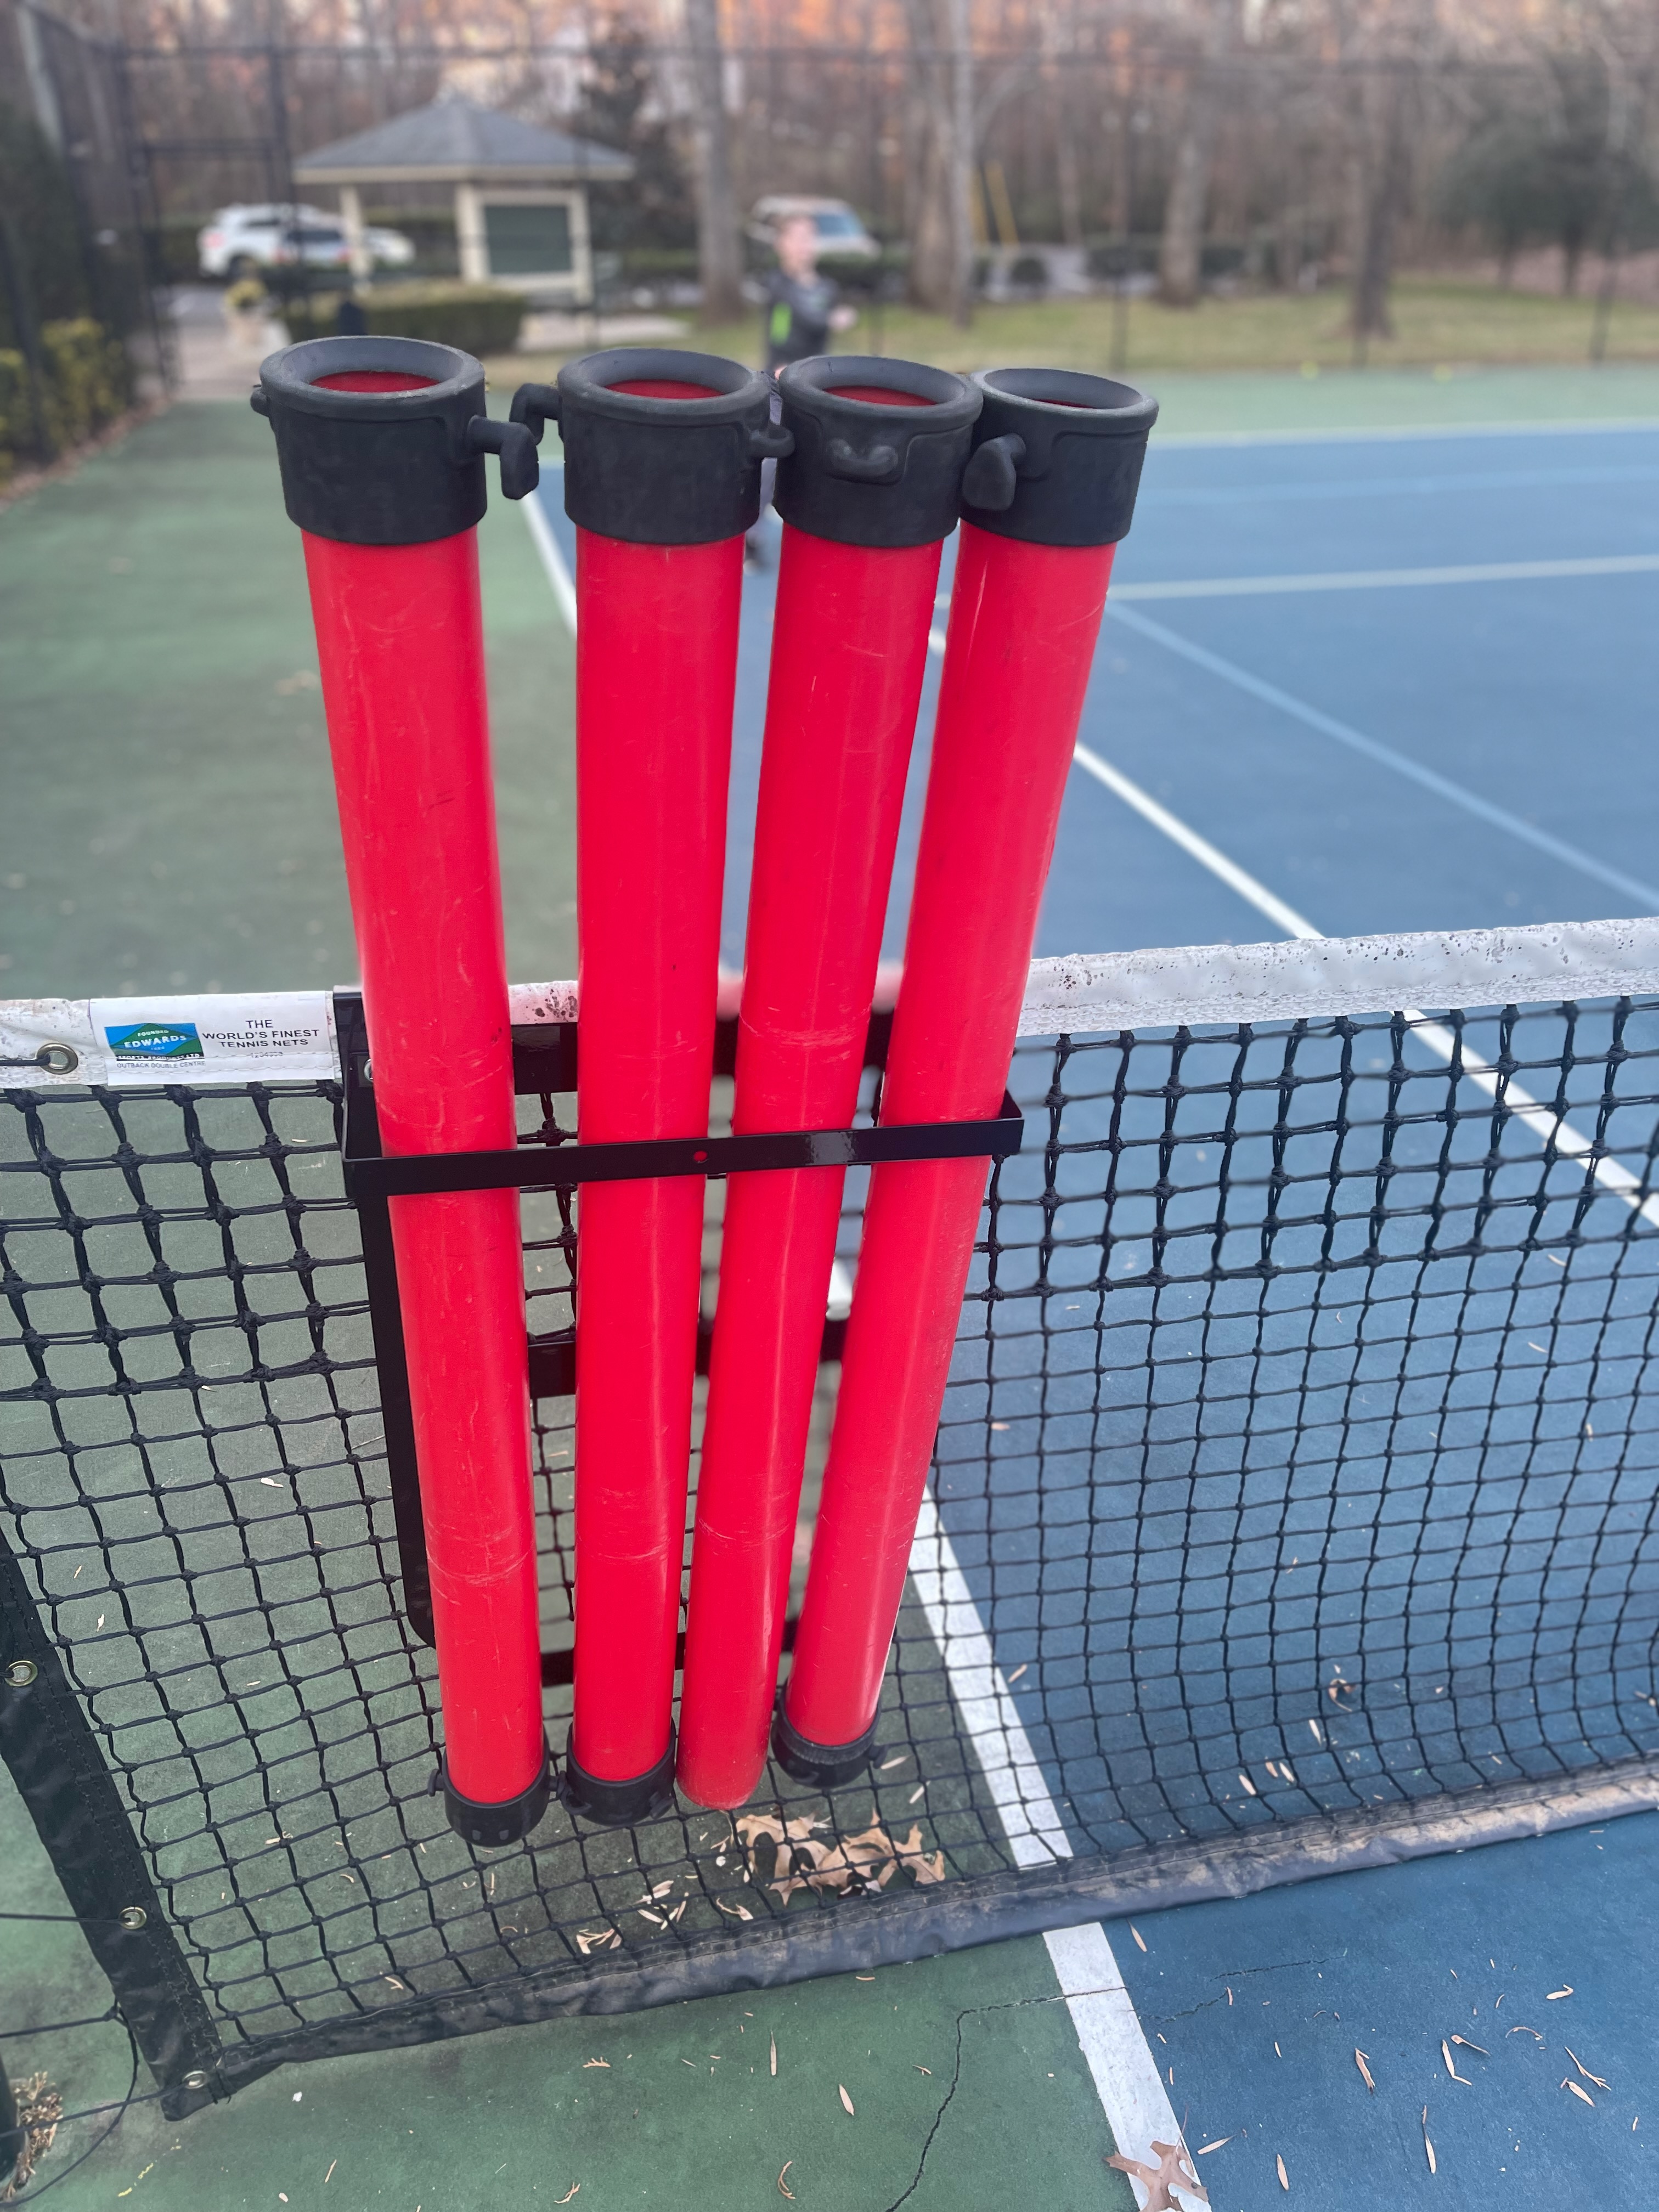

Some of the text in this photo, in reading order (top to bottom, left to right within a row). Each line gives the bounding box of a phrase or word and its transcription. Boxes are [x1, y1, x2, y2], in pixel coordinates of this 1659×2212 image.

[246, 1020, 273, 1028] THE
[272, 1030, 319, 1038] FINEST
[124, 1035, 187, 1048] EDWARDS
